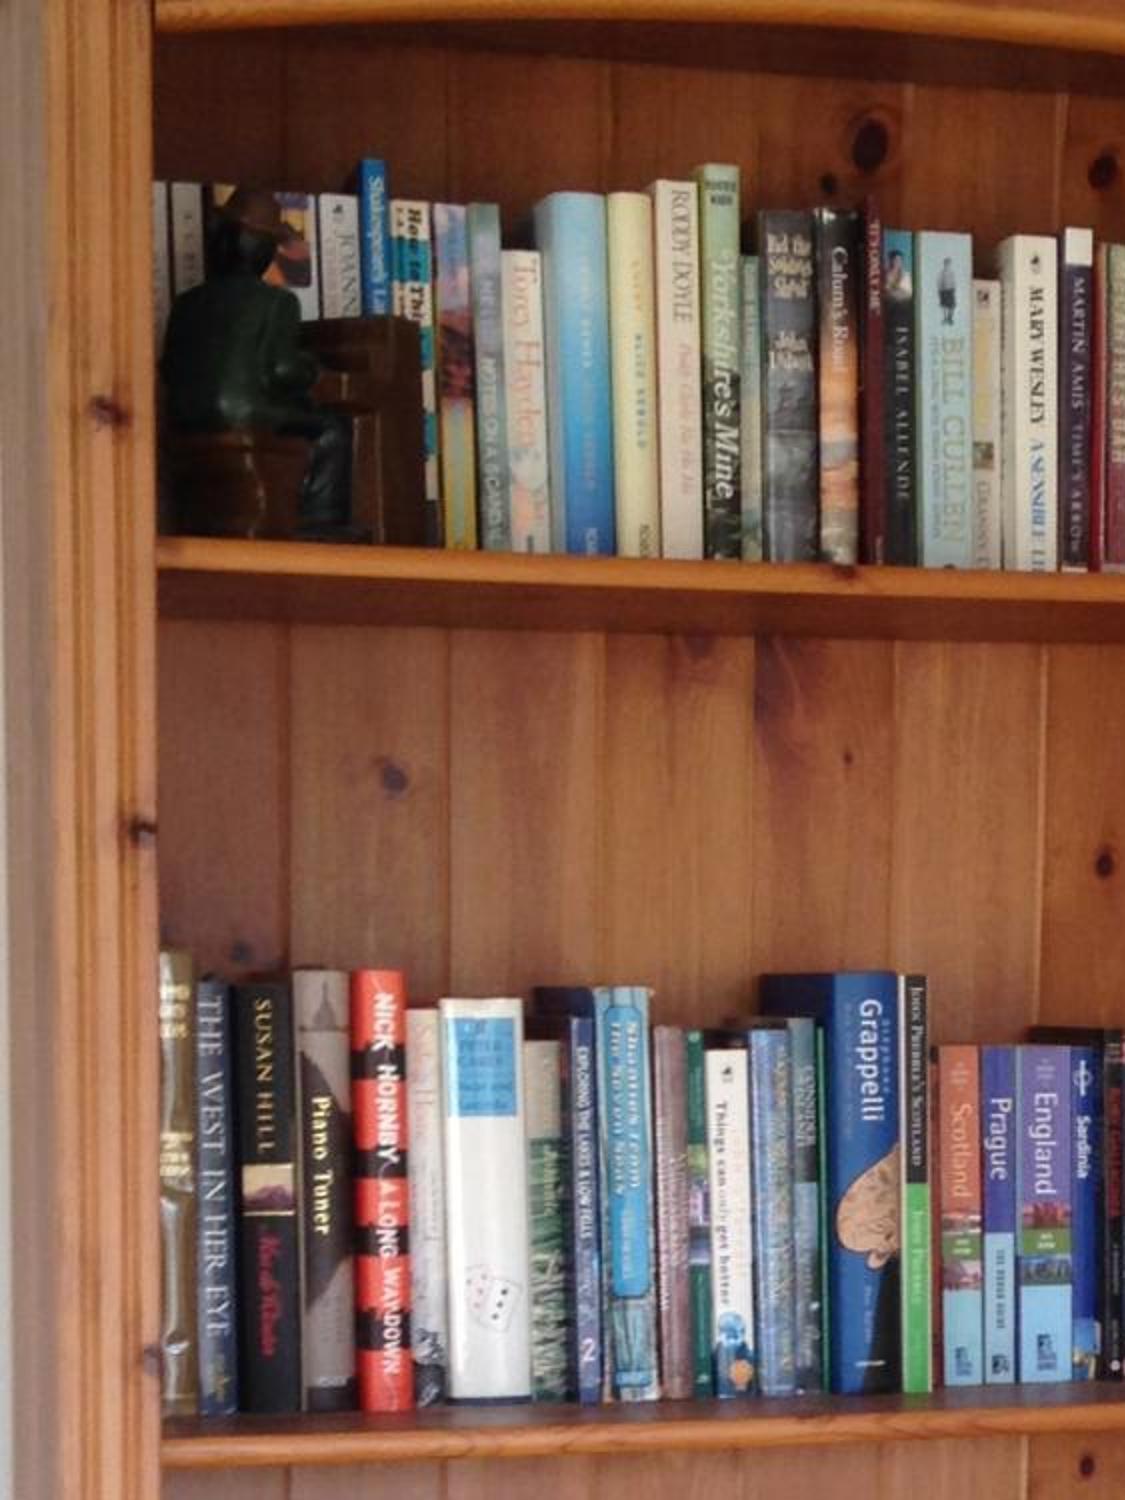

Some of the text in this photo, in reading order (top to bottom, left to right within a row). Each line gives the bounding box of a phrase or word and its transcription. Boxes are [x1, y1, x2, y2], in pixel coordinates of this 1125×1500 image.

[338, 235, 358, 317] JOANN
[407, 208, 423, 252] How
[672, 190, 694, 323] RODDY DOYLE
[831, 246, 849, 319] Calum's
[407, 286, 426, 321] Thi
[510, 258, 542, 448] Torey Hayden
[1029, 286, 1045, 426] MARY WESLEY
[1071, 276, 1086, 410] MARTIN AMIS
[711, 259, 739, 499] Yorkshire's Mine
[895, 326, 912, 501] ISABEL ALLENDE
[941, 336, 967, 544] BILL CULLEN
[1030, 438, 1045, 452] A
[255, 998, 276, 1154] SUSAN HILL
[371, 991, 400, 1163] NICK HORNBY
[855, 998, 885, 1121] Grappelli
[197, 996, 231, 1337] THE WEST IN HER EYE
[311, 1095, 335, 1237] Piano Tuner
[715, 1100, 730, 1153] Things
[950, 1102, 974, 1198] Scotland
[984, 1097, 1013, 1181] Prague
[1029, 1091, 1059, 1195] England
[1076, 1114, 1092, 1179] Sardinia
[378, 1178, 403, 1375] A LONG WAY DOWN
[716, 1223, 731, 1248] get
